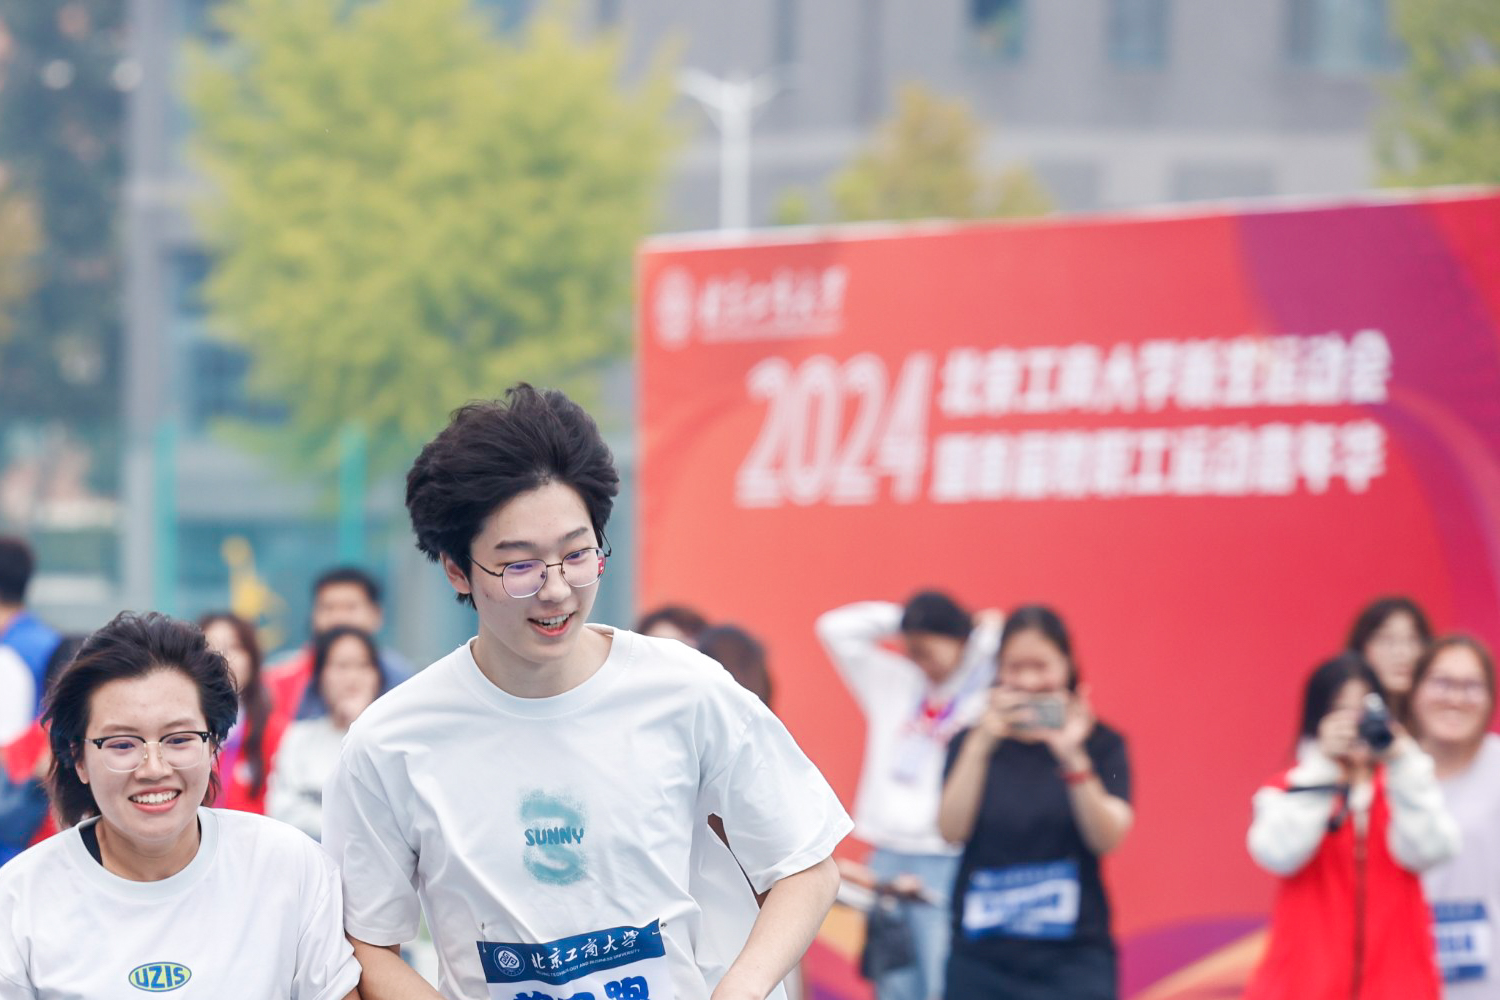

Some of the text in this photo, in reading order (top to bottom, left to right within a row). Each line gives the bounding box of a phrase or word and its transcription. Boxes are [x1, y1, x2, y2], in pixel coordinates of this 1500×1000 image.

[735, 351, 936, 508] 2024
[524, 826, 584, 846] SUNNY
[134, 965, 186, 988] UZIS
